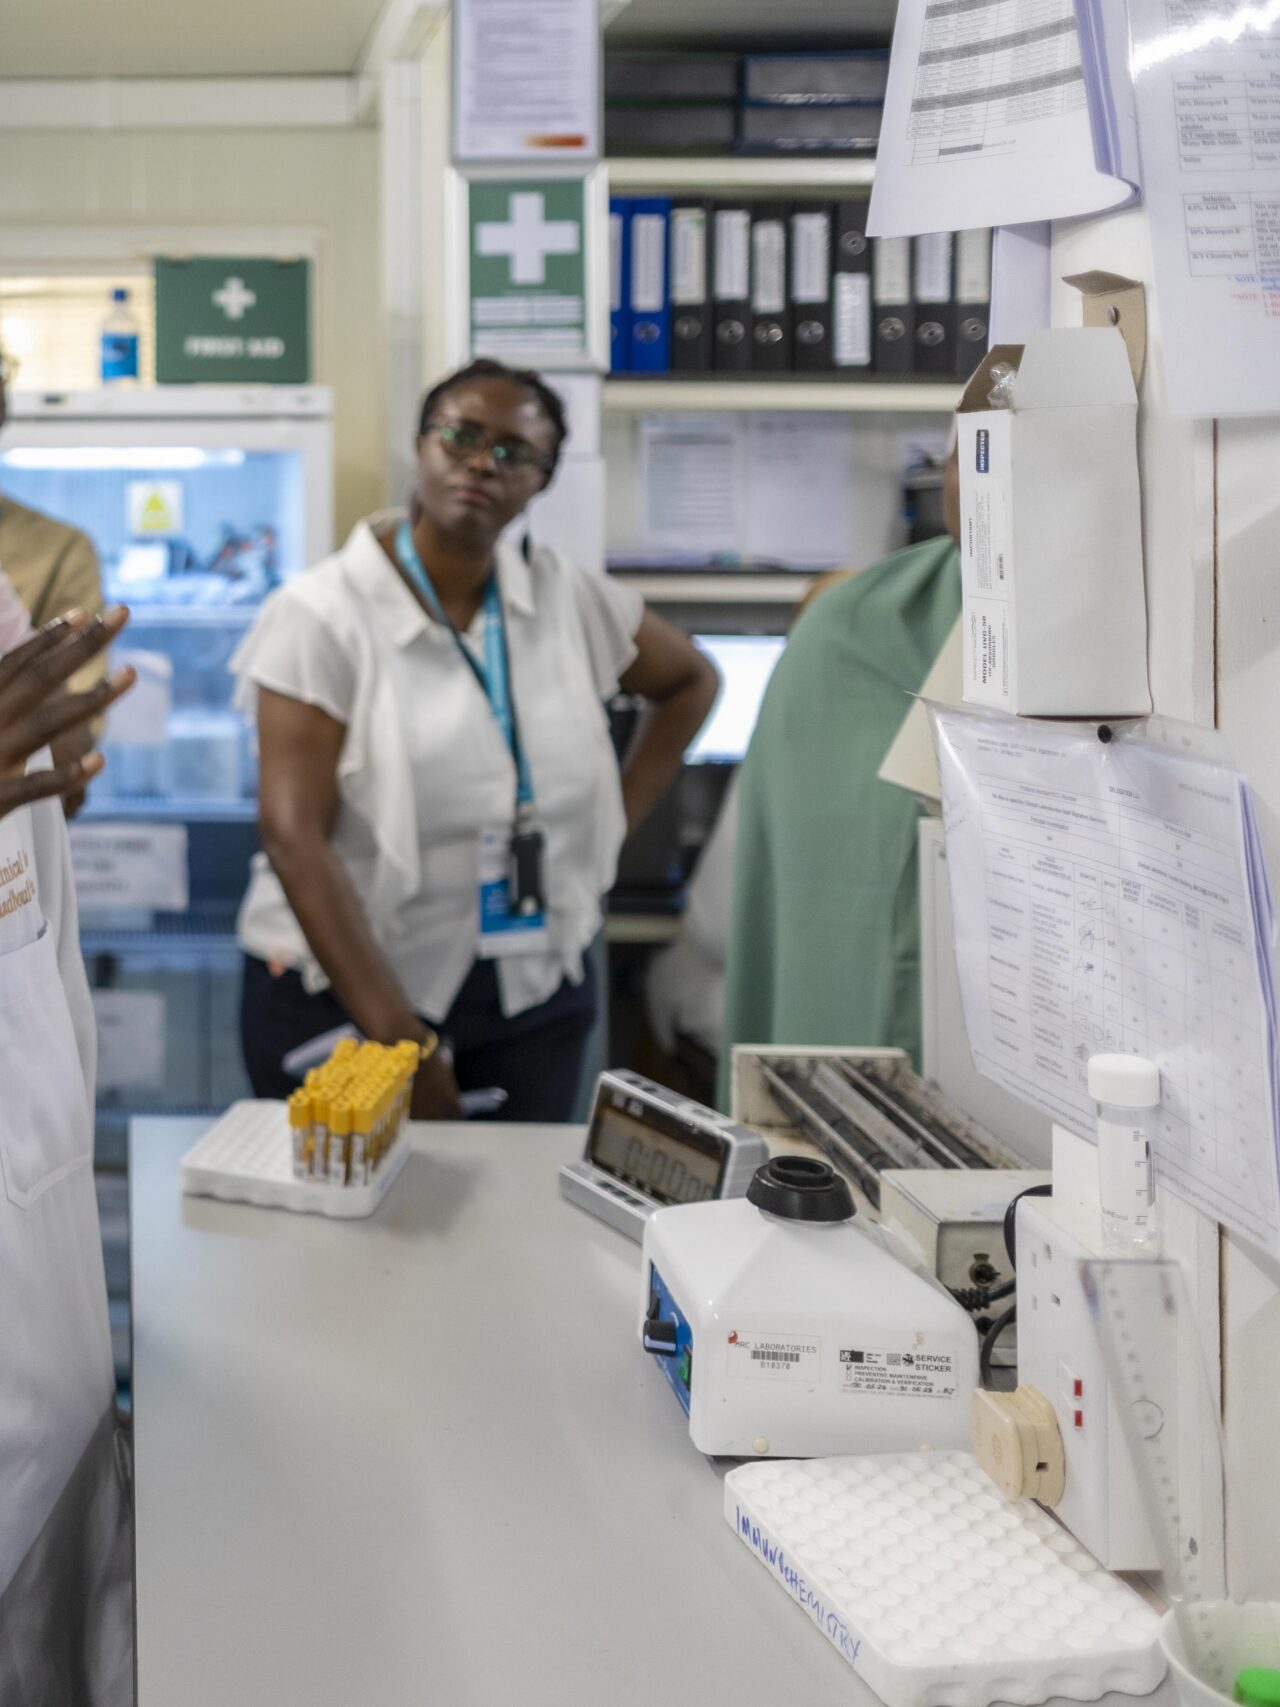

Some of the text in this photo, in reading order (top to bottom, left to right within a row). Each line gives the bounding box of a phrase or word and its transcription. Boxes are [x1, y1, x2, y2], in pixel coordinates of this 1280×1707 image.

[754, 1343, 817, 1354] LABORATORIES
[915, 1354, 952, 1363] SERVICE
[915, 1364, 952, 1373] STICKER
